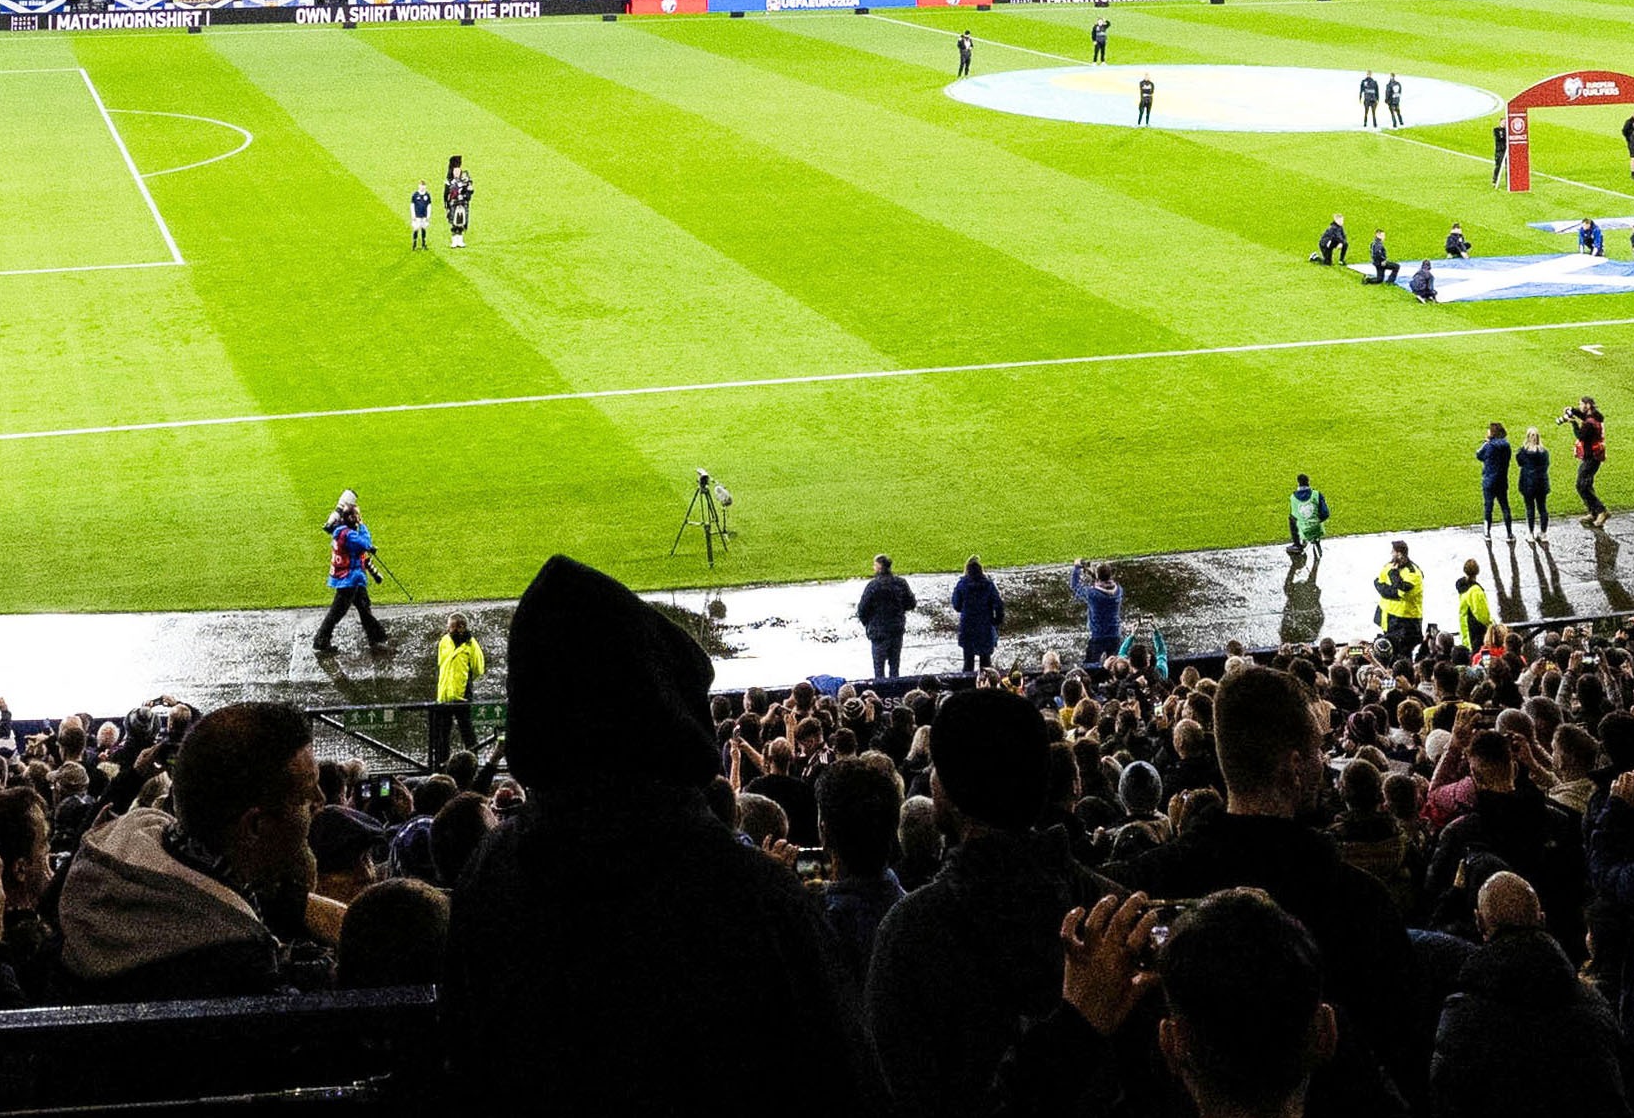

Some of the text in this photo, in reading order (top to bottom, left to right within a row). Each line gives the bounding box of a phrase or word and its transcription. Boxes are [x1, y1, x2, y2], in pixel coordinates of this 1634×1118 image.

[56, 11, 203, 30] MATCHWORNSHIRT
[295, 1, 540, 25] OWN A SHIRT WORN ON THE PITCH
